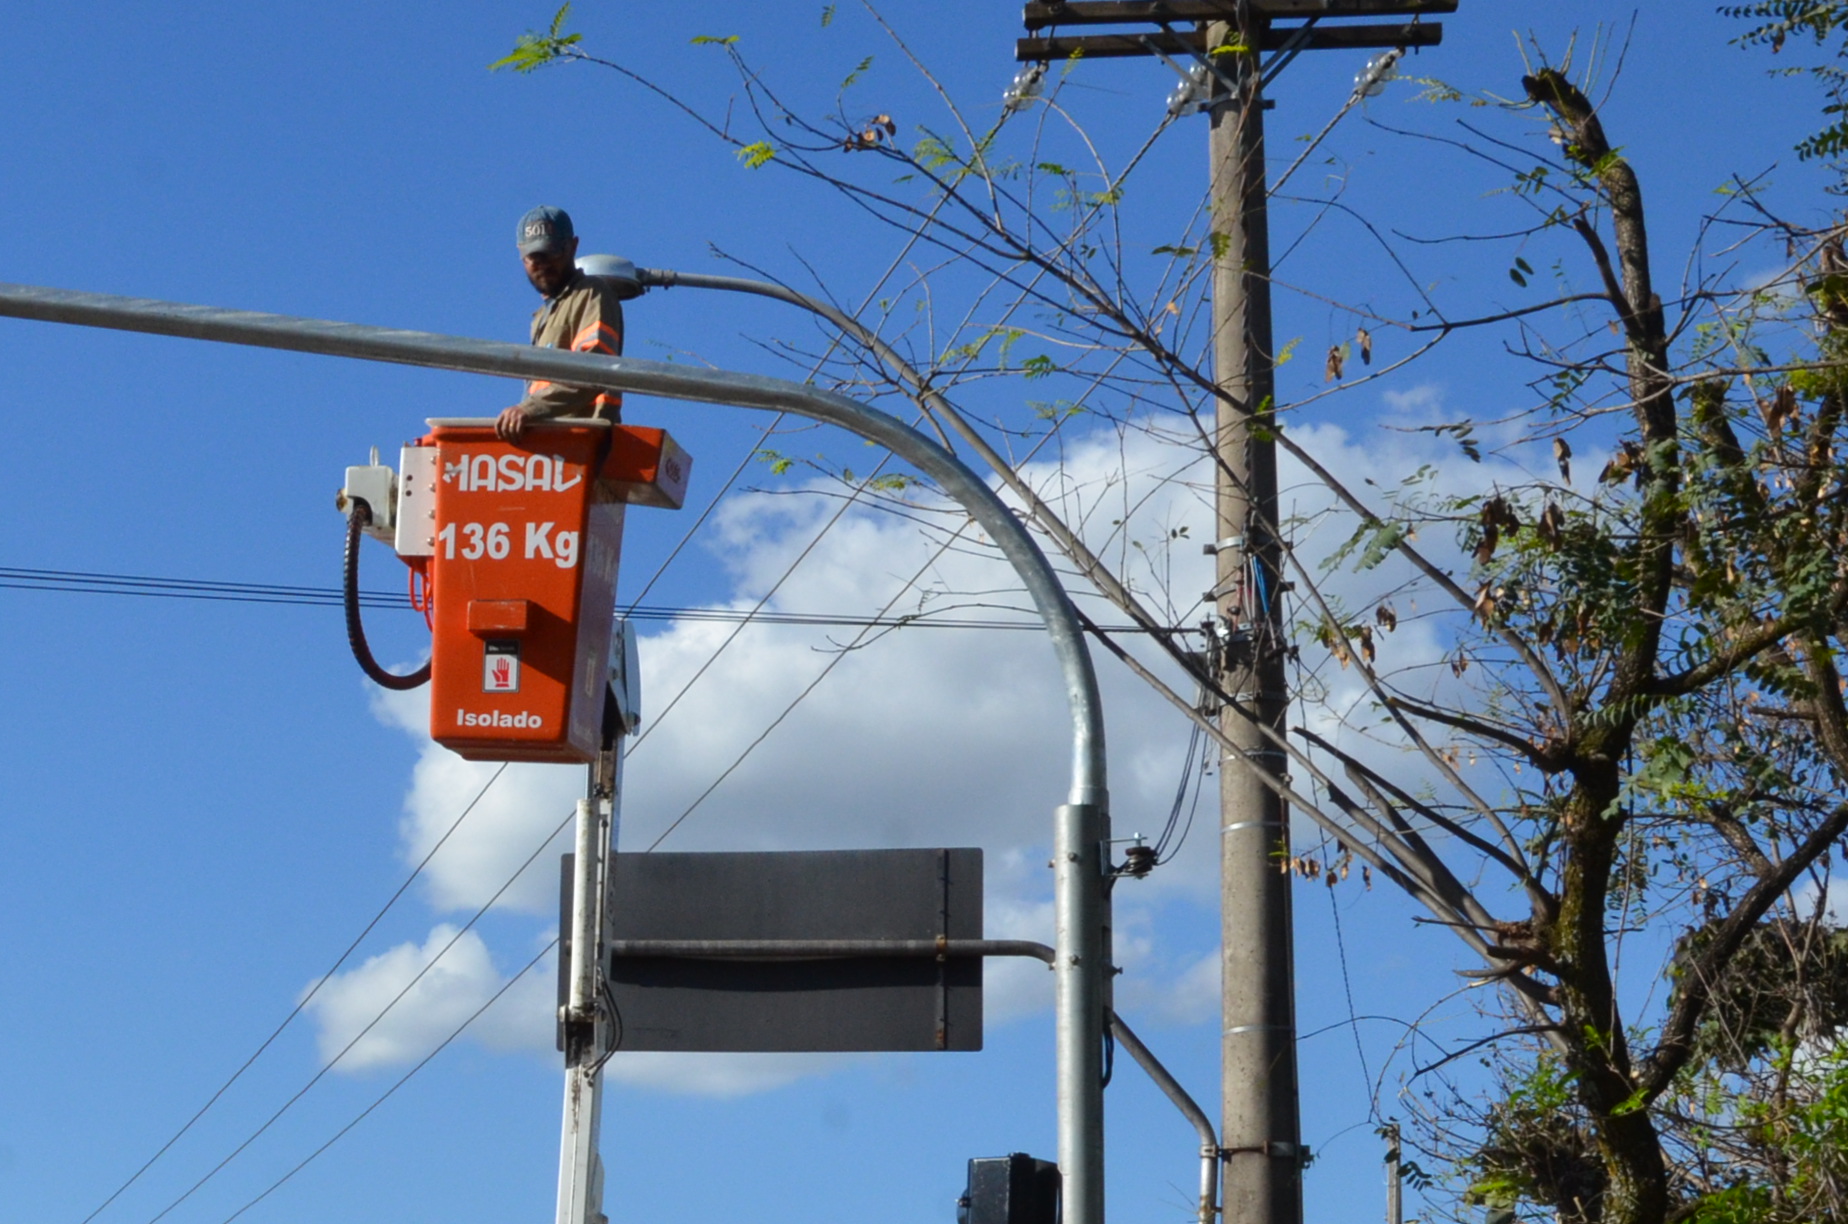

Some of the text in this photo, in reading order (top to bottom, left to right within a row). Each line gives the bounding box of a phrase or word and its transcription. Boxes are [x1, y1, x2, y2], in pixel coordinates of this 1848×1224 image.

[438, 522, 510, 560] 136
[525, 522, 579, 568] Kg
[456, 708, 542, 728] Isolado
